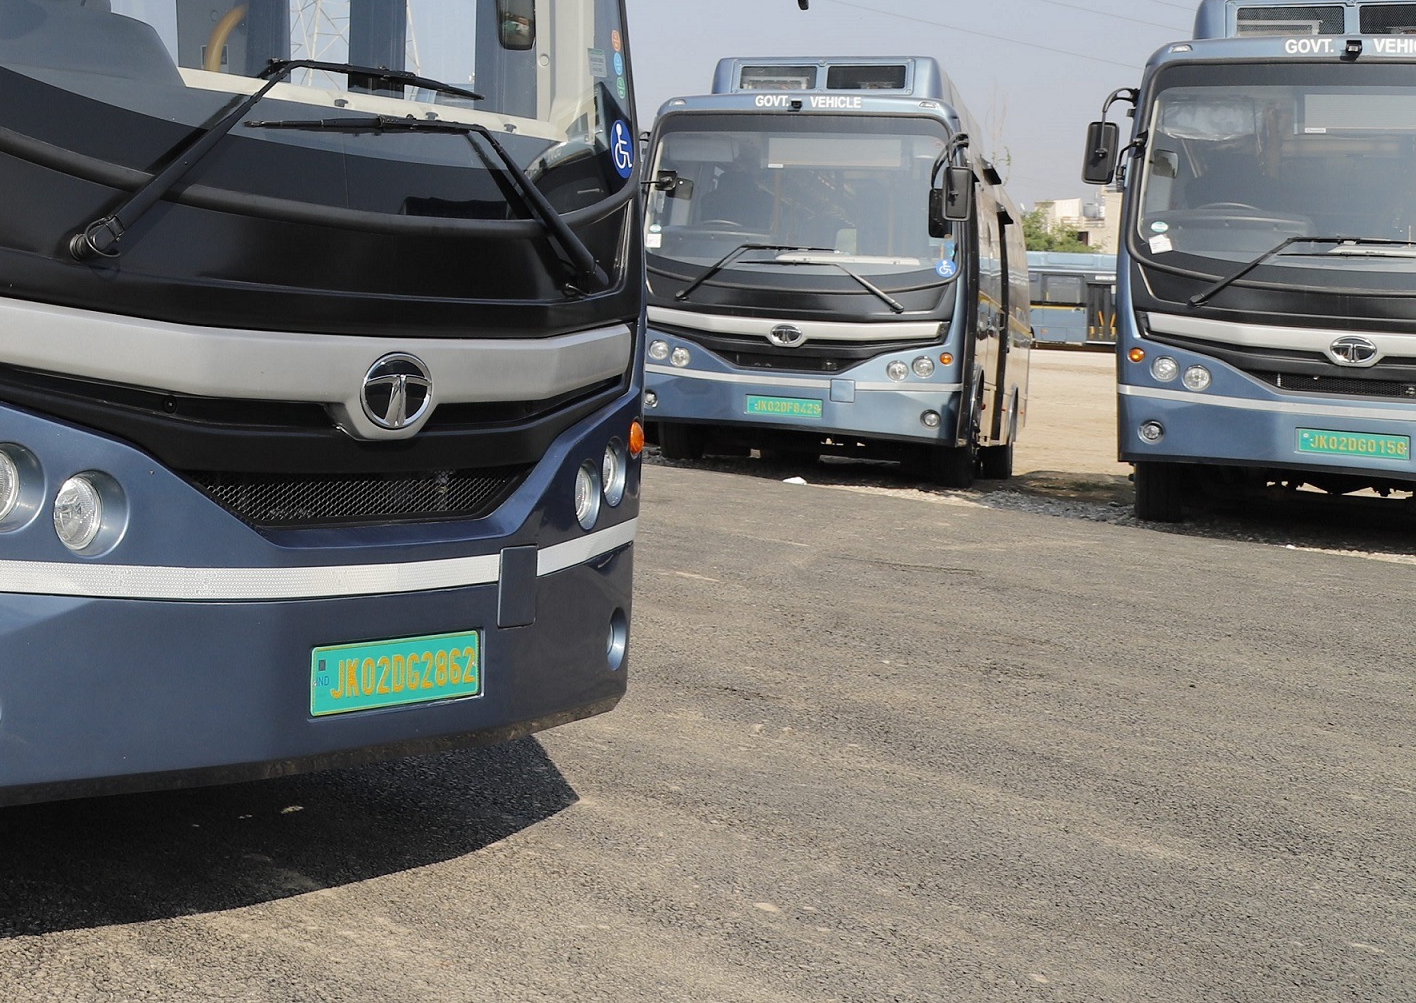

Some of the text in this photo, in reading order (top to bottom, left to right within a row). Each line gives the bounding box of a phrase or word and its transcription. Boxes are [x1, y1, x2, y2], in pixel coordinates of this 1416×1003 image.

[1285, 38, 1416, 54] GOVT. VEHI
[755, 95, 862, 108] GOVT. VEHICLE
[1310, 434, 1406, 455] JK02DG0158
[330, 646, 476, 699] JK02DG2862
